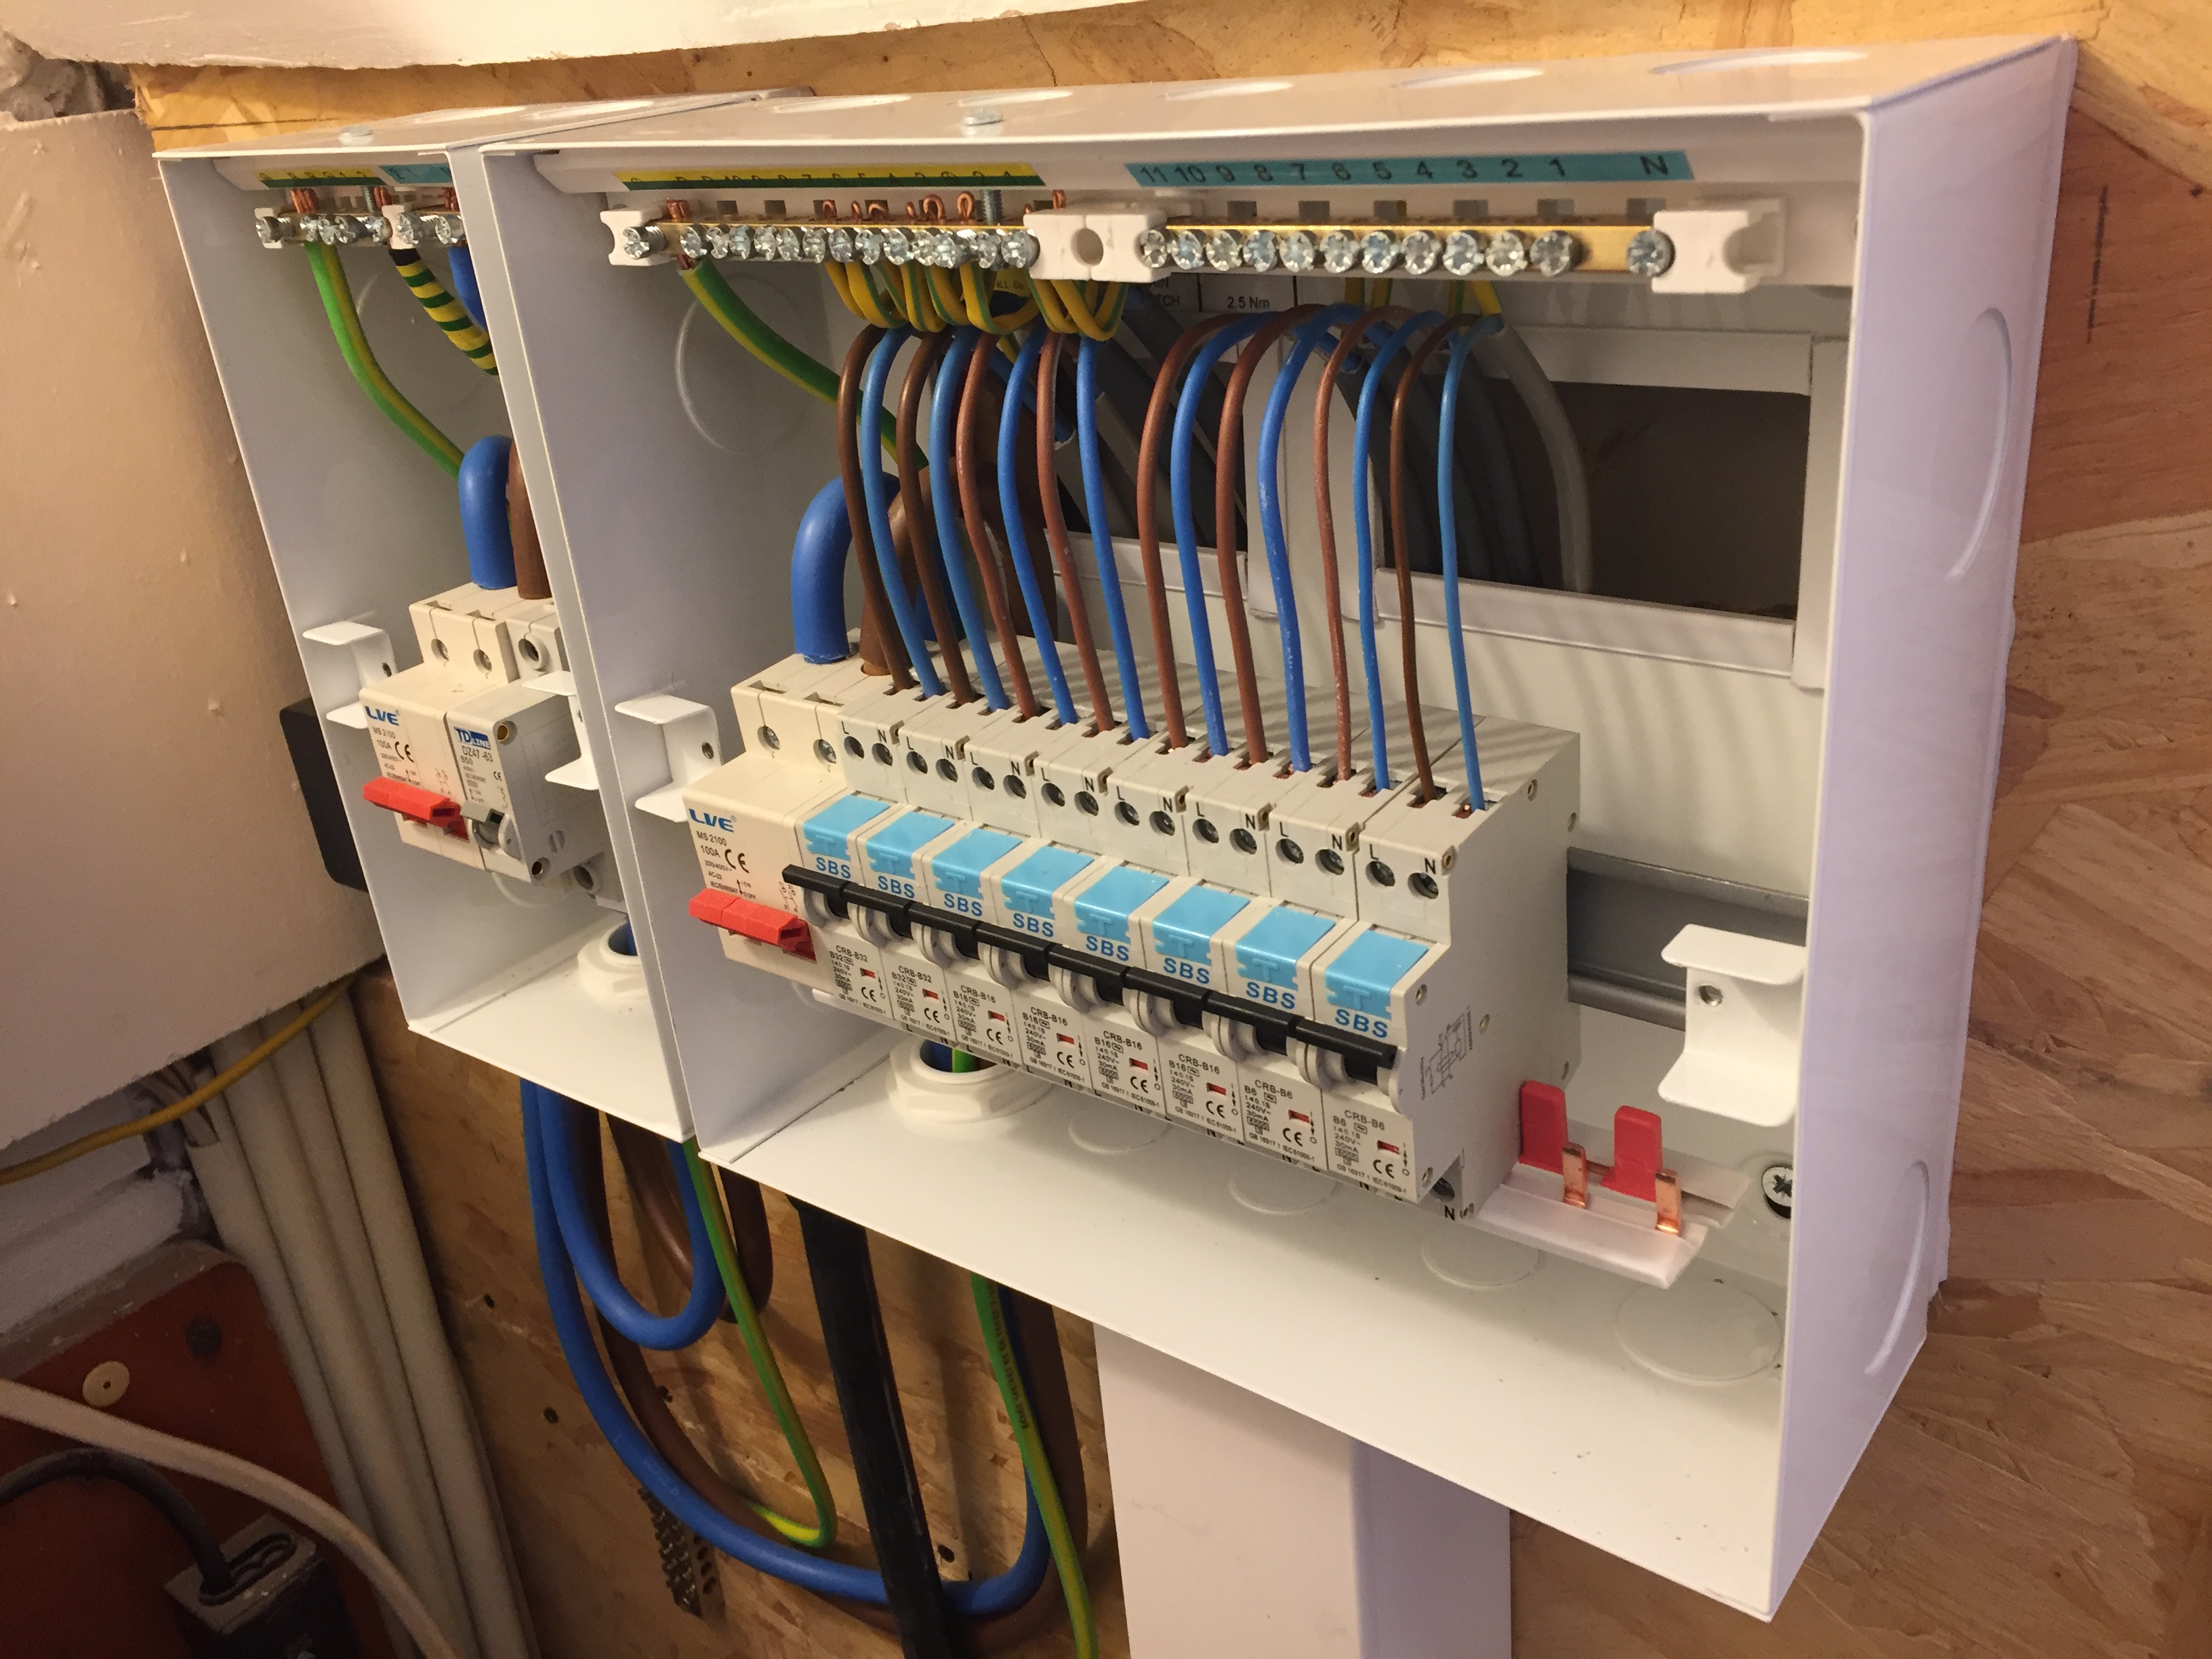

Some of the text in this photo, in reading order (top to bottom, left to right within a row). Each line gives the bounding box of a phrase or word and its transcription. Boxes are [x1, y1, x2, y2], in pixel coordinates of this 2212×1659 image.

[1140, 166, 1168, 183] 11
[1174, 164, 1206, 183] 10
[1253, 163, 1274, 182] 8
[1290, 163, 1306, 180] 7
[1372, 161, 1392, 180] 5
[1416, 160, 1433, 179] 4
[1456, 159, 1478, 179] 3
[1501, 158, 1523, 178] 2
[1549, 158, 1565, 176] 1
[1639, 154, 1668, 175] N
[1227, 295, 1270, 309] 2.5 Nm
[841, 721, 887, 743] L N
[907, 736, 954, 760] L N
[970, 752, 1021, 776] L N
[1042, 767, 1094, 792] L N
[1117, 786, 1172, 813] L N
[1197, 802, 1256, 830] L N
[696, 830, 727, 846] MS 2100
[1280, 822, 1343, 849] L N
[701, 844, 720, 858] 100A
[1370, 844, 1436, 874] L N
[816, 857, 852, 879] SBS
[878, 876, 915, 899] SBS
[943, 893, 983, 917] SBS
[1013, 913, 1054, 937] SBS
[829, 950, 844, 962] B32
[836, 945, 868, 962] CRB-B32
[1086, 935, 1129, 961] SBS
[891, 971, 906, 982] B32
[898, 965, 932, 983] CRB-B32
[1164, 958, 1210, 984] SBS
[953, 990, 968, 1002] B16
[961, 985, 996, 1003] CRB-B16
[1246, 981, 1295, 1009] SBS
[1023, 1012, 1038, 1024] B16
[1031, 1006, 1067, 1026] CRB-B16
[1335, 1008, 1387, 1038] SBS
[1094, 1036, 1111, 1048] B16
[1103, 1030, 1143, 1050] CRB-B16
[1169, 1060, 1186, 1071] B16
[1179, 1054, 1220, 1075] CRB-B16
[1244, 1085, 1257, 1096] B6
[1254, 1080, 1293, 1099] CRB-B6
[1333, 1115, 1347, 1126] B6
[1344, 1109, 1385, 1130] CRB-B6
[1444, 1206, 1455, 1221] N
